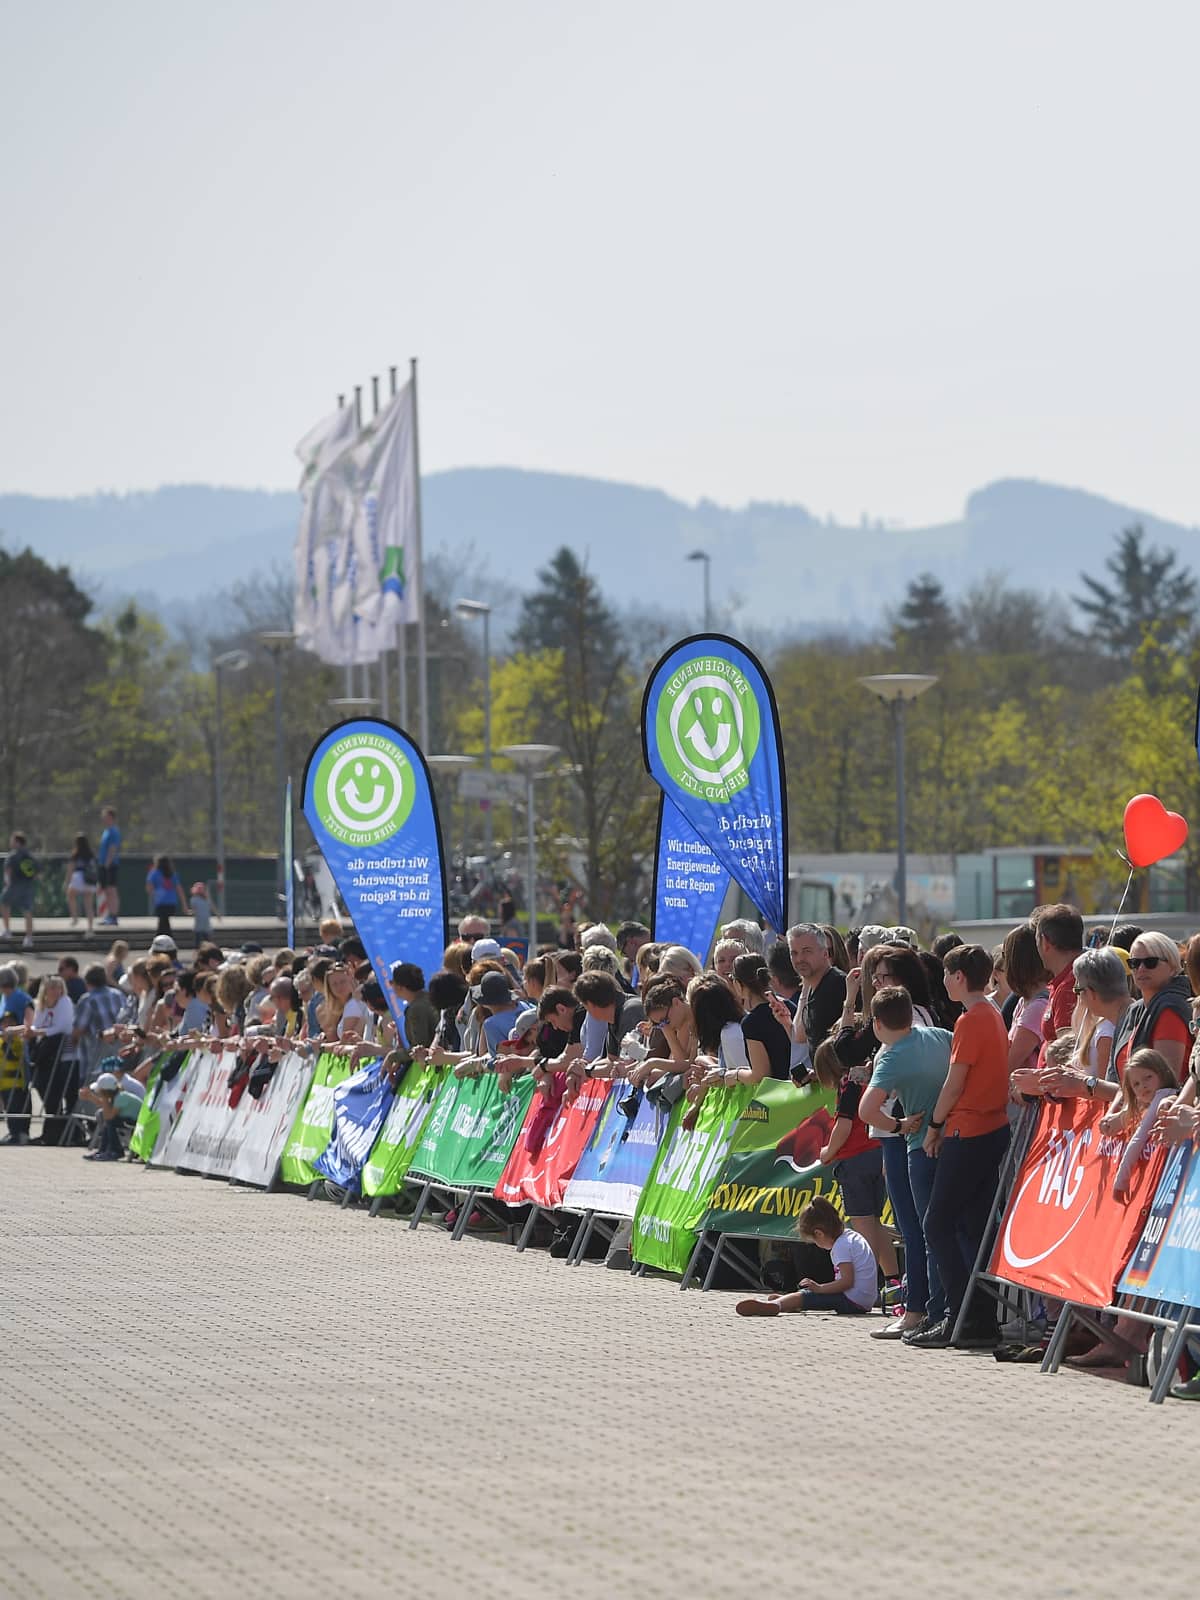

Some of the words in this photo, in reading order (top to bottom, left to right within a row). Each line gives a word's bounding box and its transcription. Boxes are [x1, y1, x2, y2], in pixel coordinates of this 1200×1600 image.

[668, 839, 682, 852] Wir
[683, 841, 711, 855] treiben
[667, 858, 720, 875] Energiewende
[665, 876, 674, 889] in
[675, 878, 689, 890] der
[689, 879, 715, 894] Region
[664, 896, 689, 908] voran.
[1037, 1127, 1092, 1210] VAG
